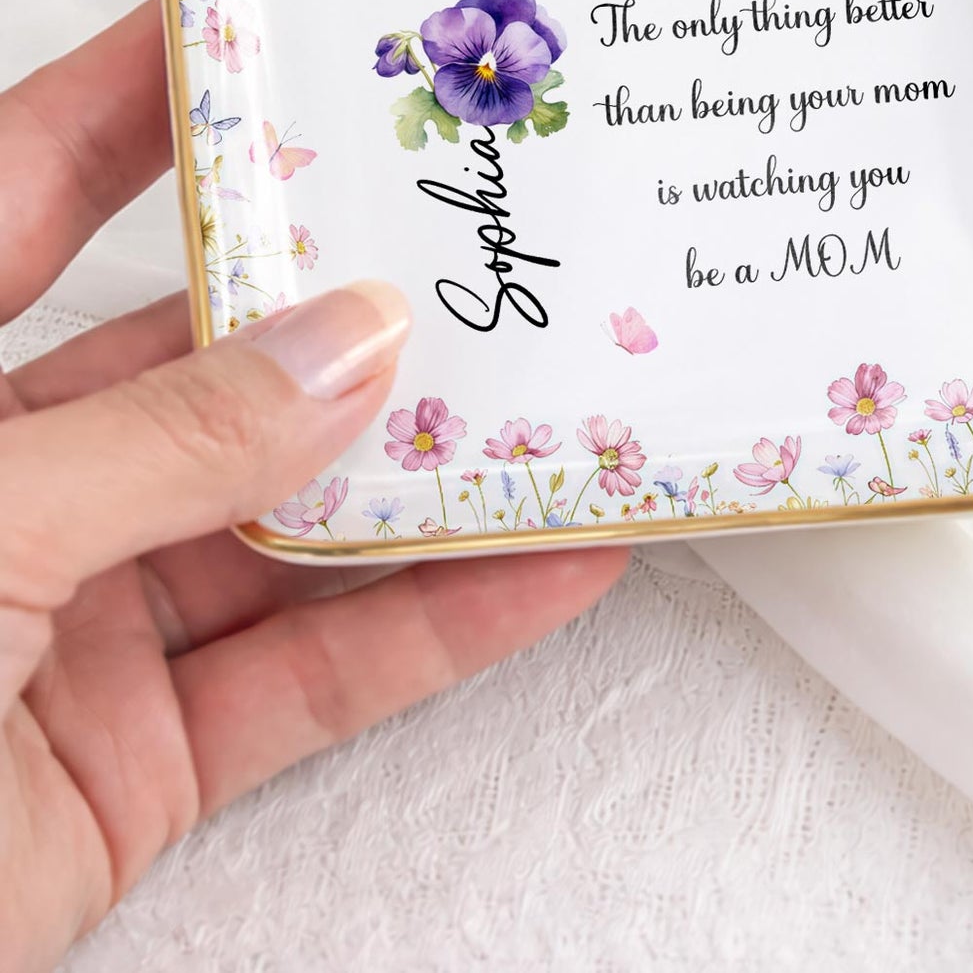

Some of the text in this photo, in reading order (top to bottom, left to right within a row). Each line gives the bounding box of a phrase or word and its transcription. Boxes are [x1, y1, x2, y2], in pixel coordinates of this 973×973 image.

[591, 78, 958, 134] than being your mom
[657, 154, 912, 212] is watching you
[416, 124, 562, 333] Sophia
[686, 226, 902, 289] be a MOM
